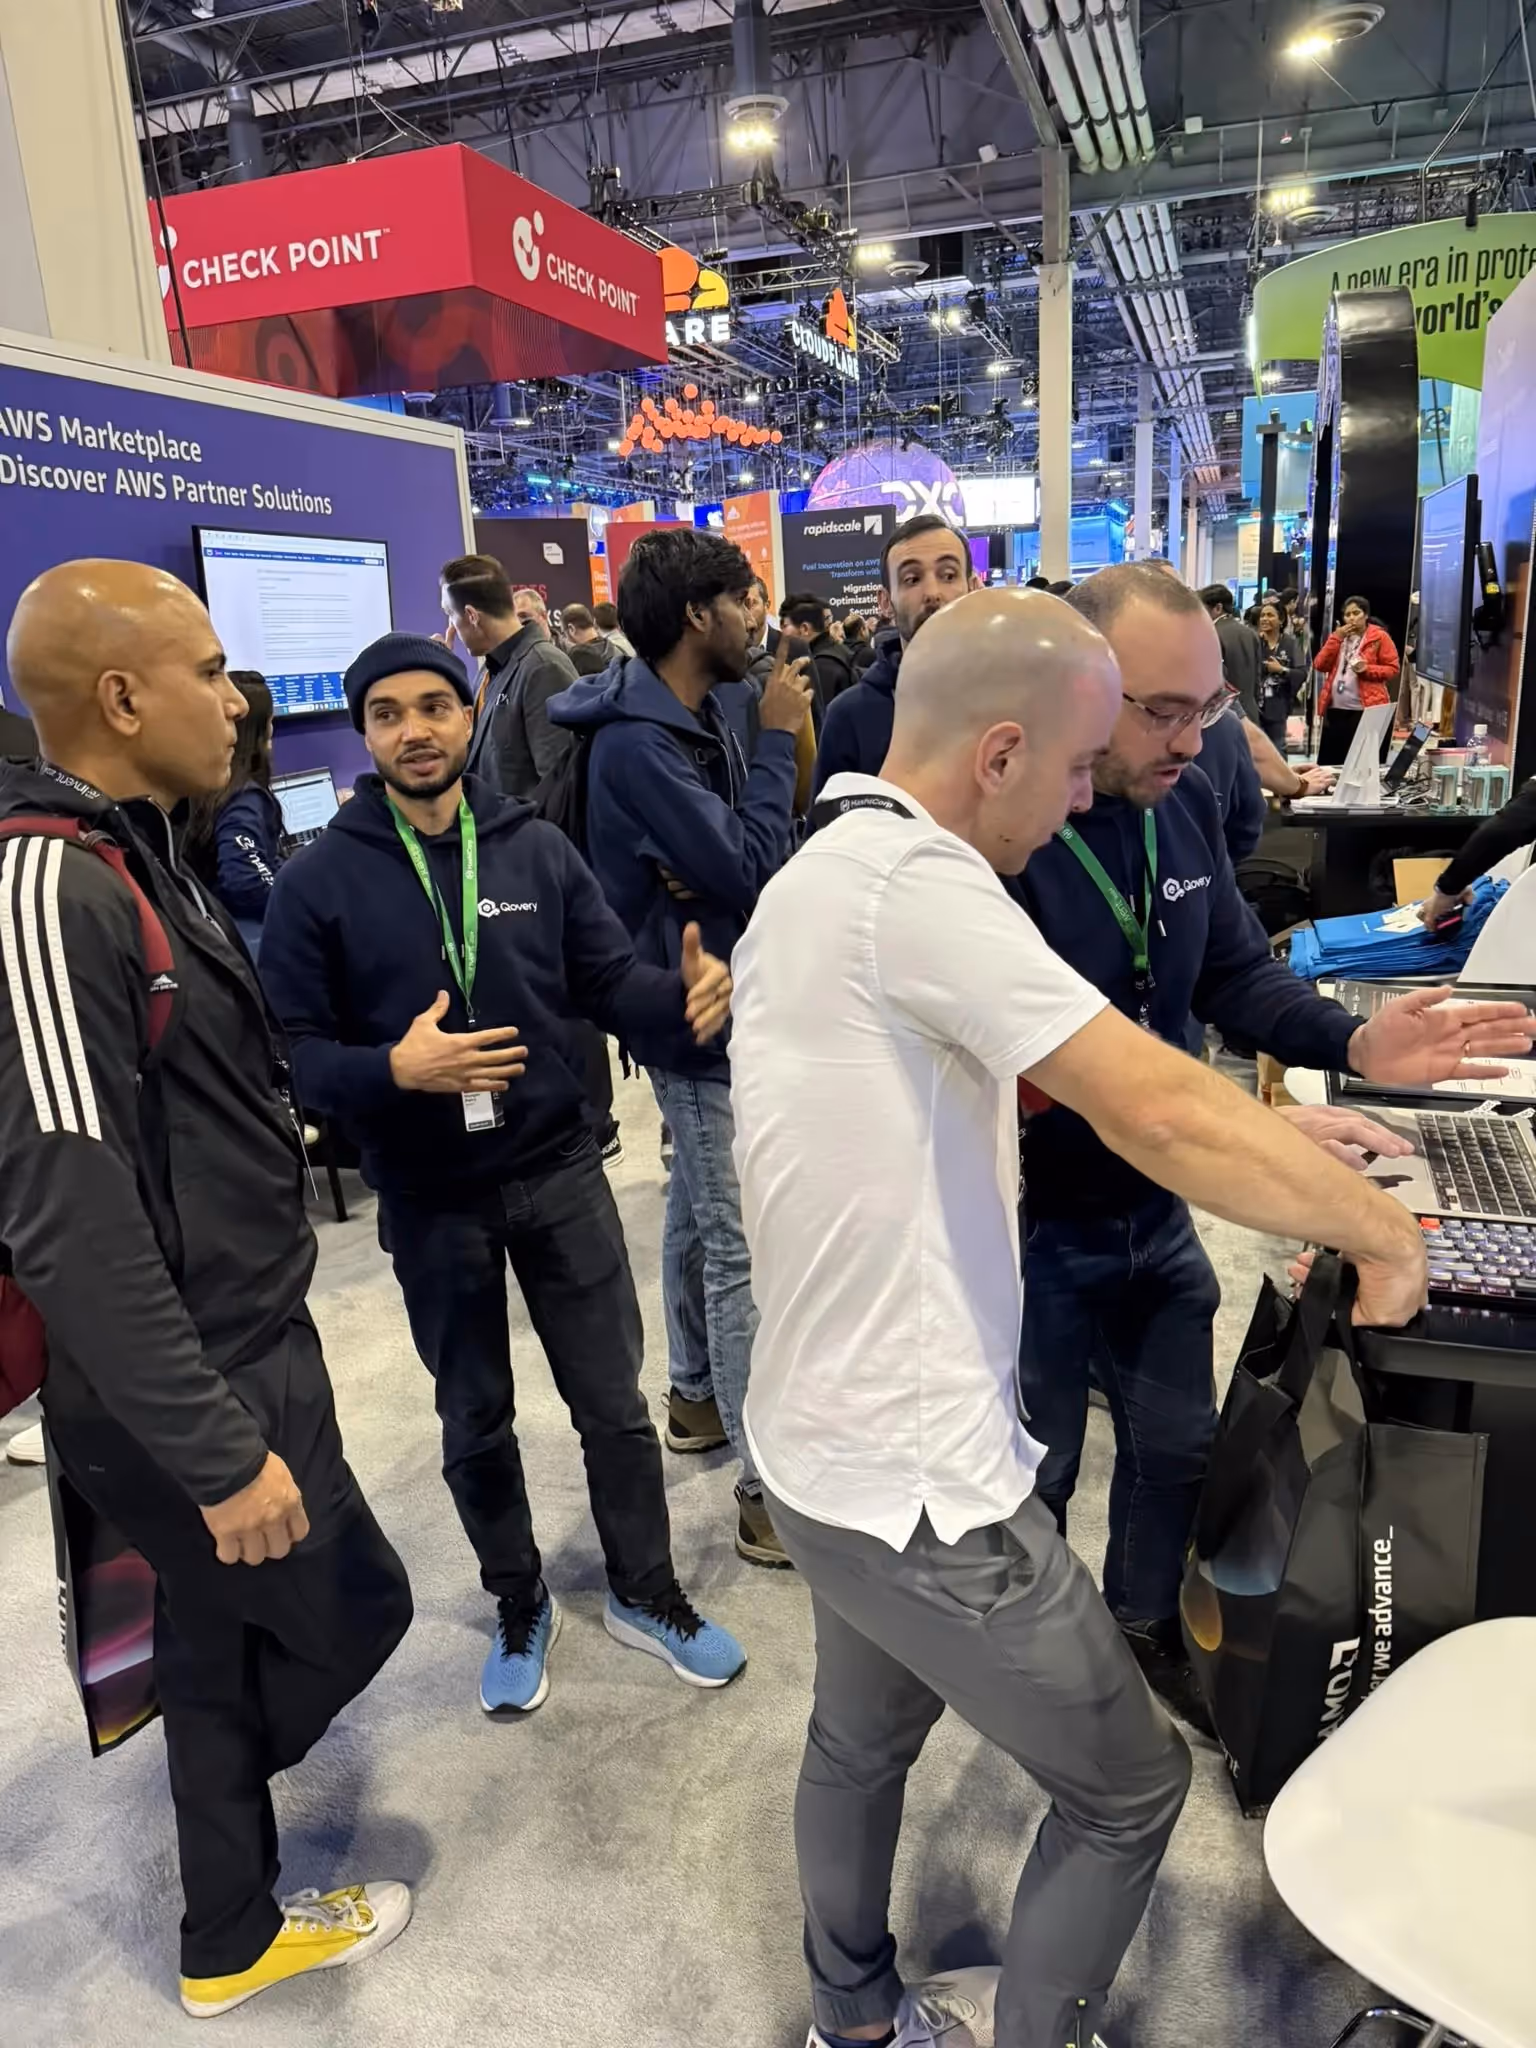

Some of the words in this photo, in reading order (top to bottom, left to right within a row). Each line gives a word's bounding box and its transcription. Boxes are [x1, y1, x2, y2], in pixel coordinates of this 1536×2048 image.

[182, 245, 281, 289] CHECK
[1347, 265, 1393, 290] new
[1399, 255, 1439, 289] era
[1446, 246, 1469, 284] in
[546, 253, 597, 300] CHECK
[598, 277, 640, 317] POINT
[1416, 290, 1504, 335] orld's
[791, 319, 860, 380] CLOUDFLARE
[59, 415, 203, 464] Marketplace
[0, 454, 107, 494] Discover
[115, 467, 167, 500] AWS
[171, 473, 247, 508] Partner
[252, 482, 333, 516] Solutions
[803, 519, 862, 536] rapidscale
[802, 562, 817, 571] Fuel
[818, 560, 853, 570] Innovation
[831, 568, 865, 579] Transform
[829, 594, 879, 607] Optimizatio
[849, 605, 881, 616] Securit
[850, 797, 894, 809] HashiCorp
[1183, 874, 1212, 892] Qovery
[500, 901, 538, 912] Qovery
[1372, 1640, 1392, 1671] we
